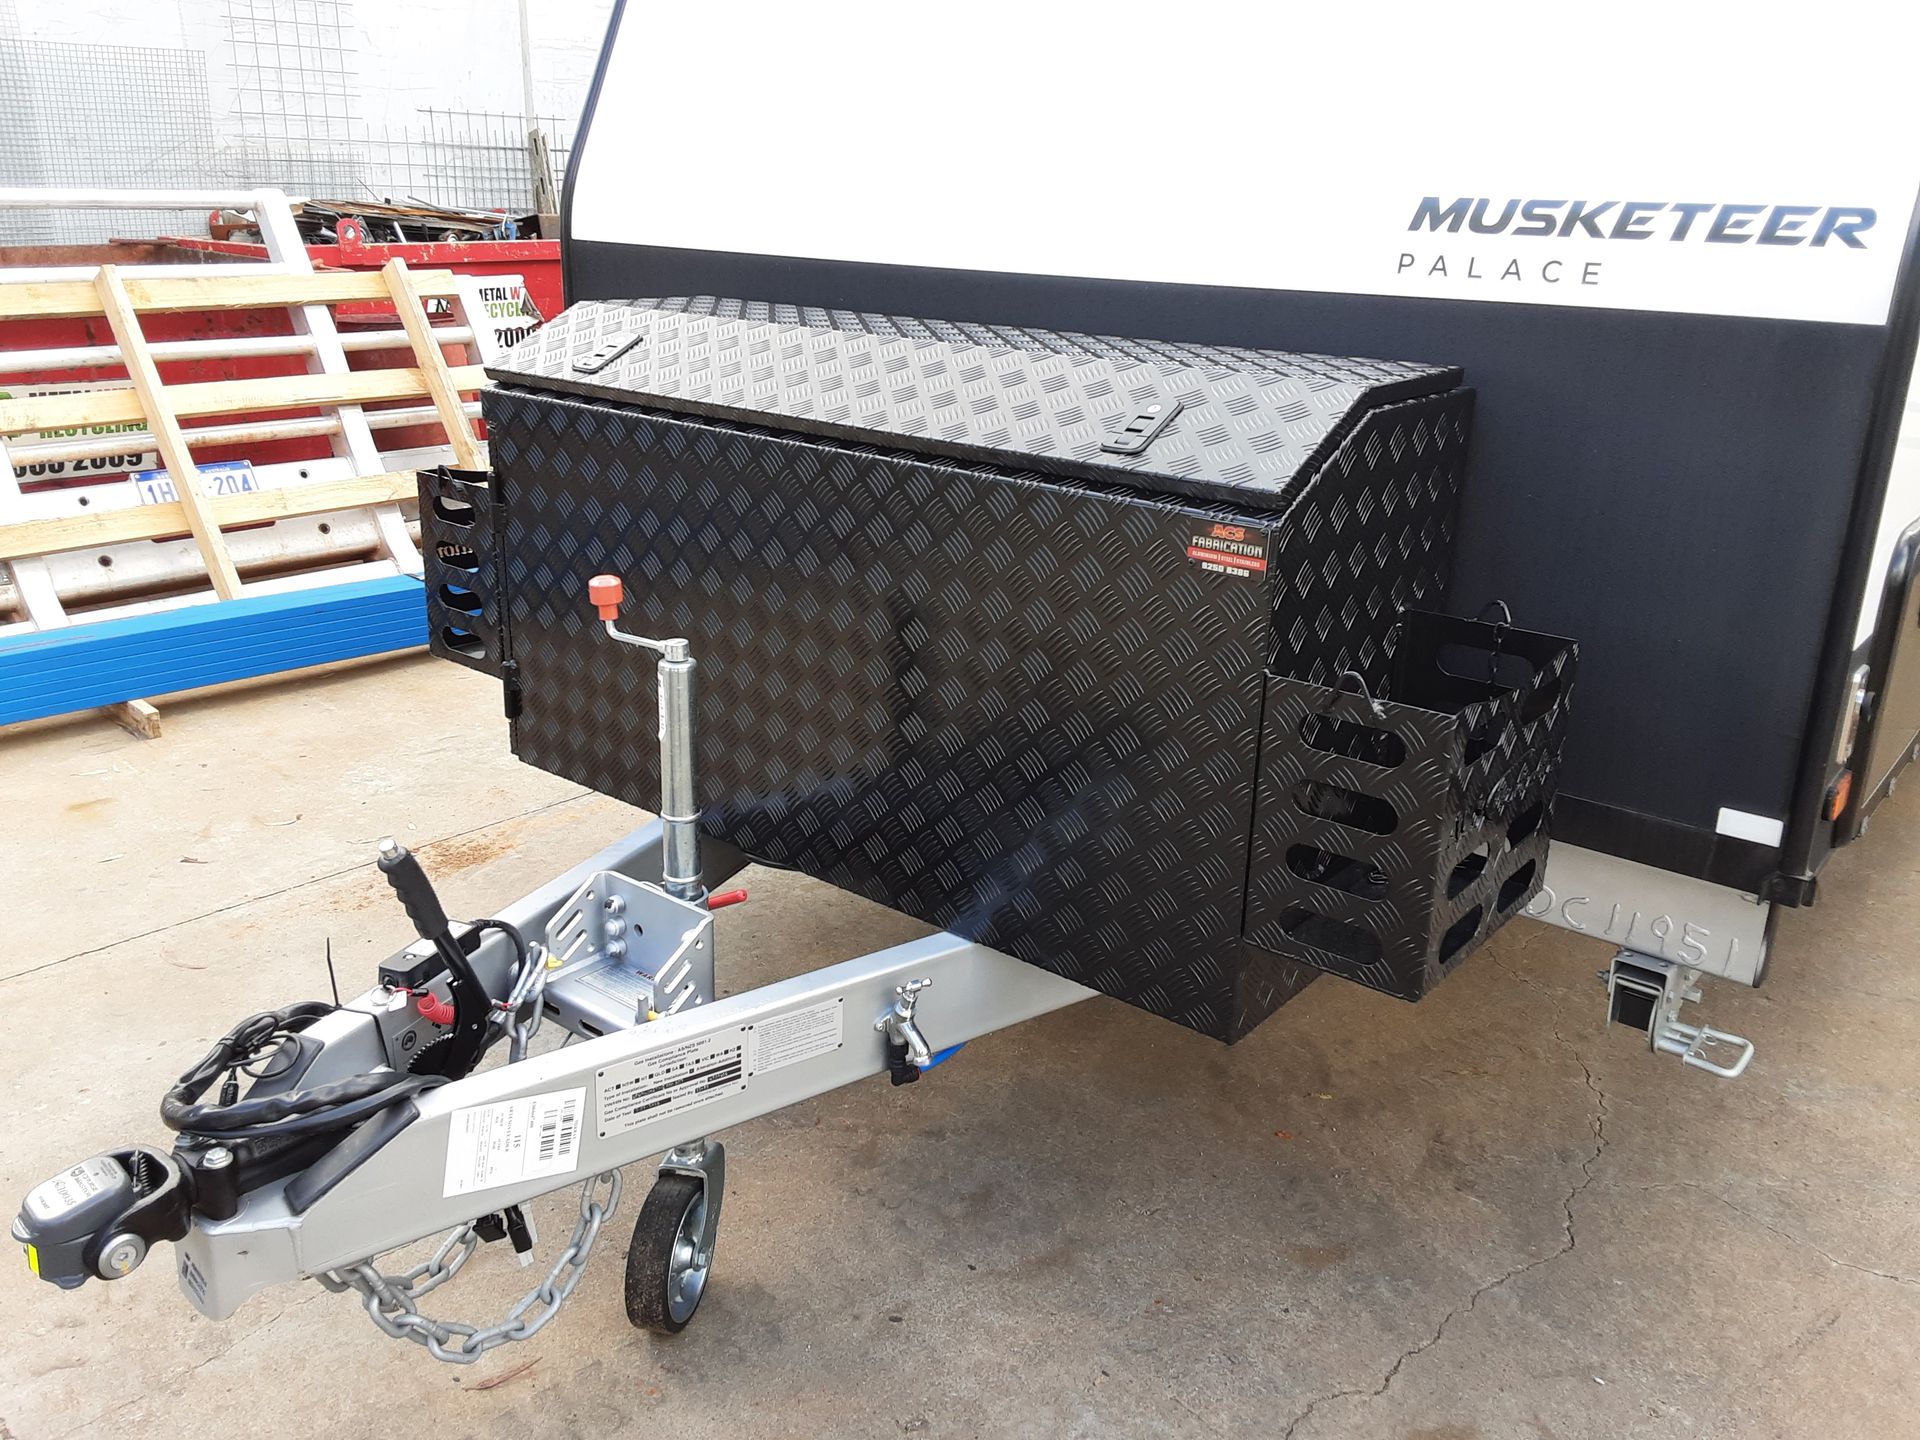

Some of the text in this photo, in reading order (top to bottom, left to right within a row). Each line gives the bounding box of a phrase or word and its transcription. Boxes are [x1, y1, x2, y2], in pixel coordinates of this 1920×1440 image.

[1407, 196, 1878, 249] MUSKETEER
[1397, 253, 1603, 285] PALACE
[1192, 535, 1263, 558] FABRICATION
[1211, 524, 1246, 542] ACS
